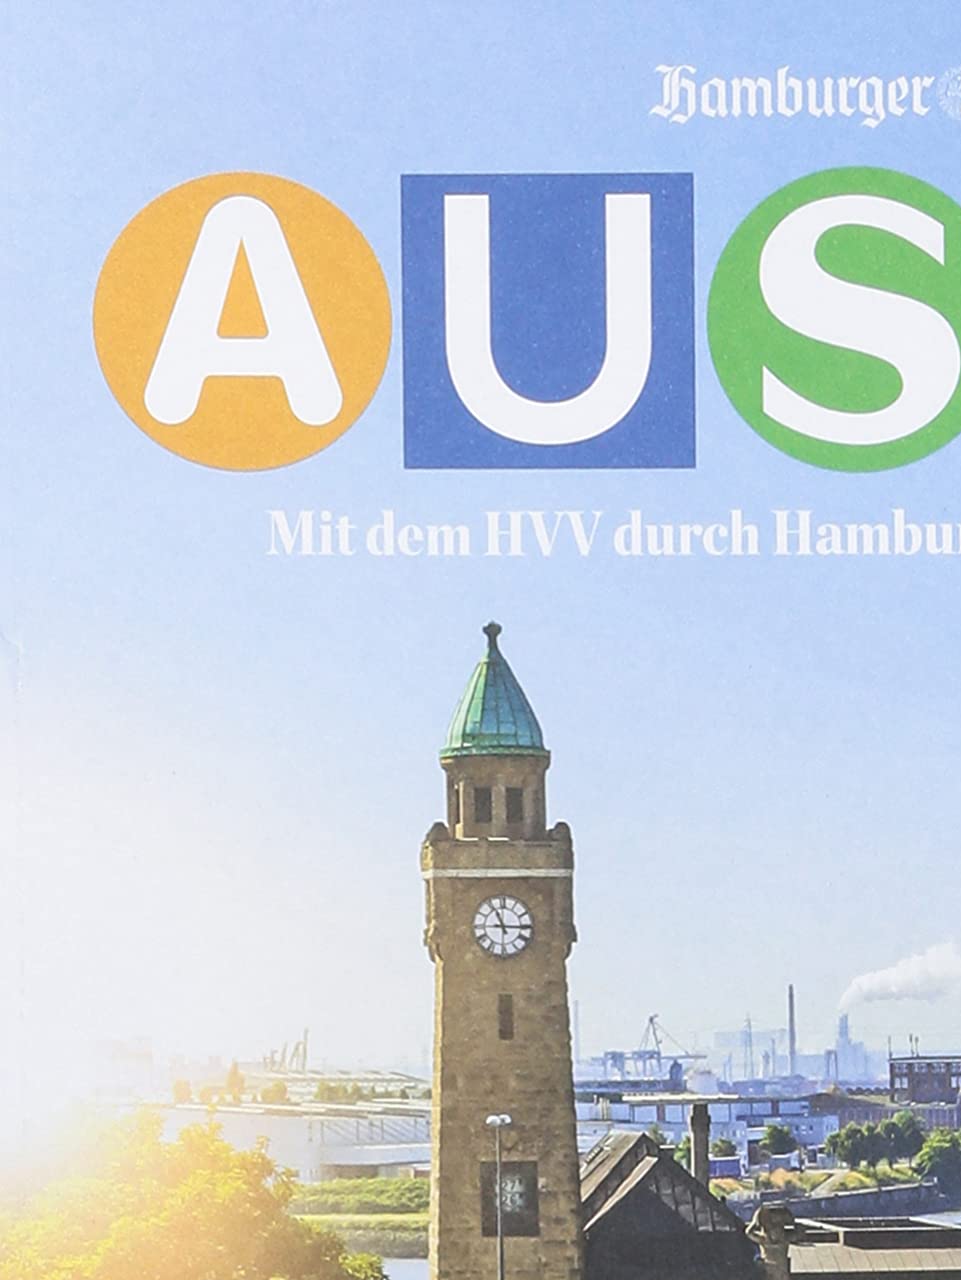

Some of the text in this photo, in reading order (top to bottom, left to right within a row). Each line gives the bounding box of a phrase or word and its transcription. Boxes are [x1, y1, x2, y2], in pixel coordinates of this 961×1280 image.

[649, 63, 936, 129] Hamburger
[266, 509, 357, 556] Mit
[366, 509, 471, 556] dem
[484, 509, 604, 557] HVV
[613, 509, 761, 556] durch
